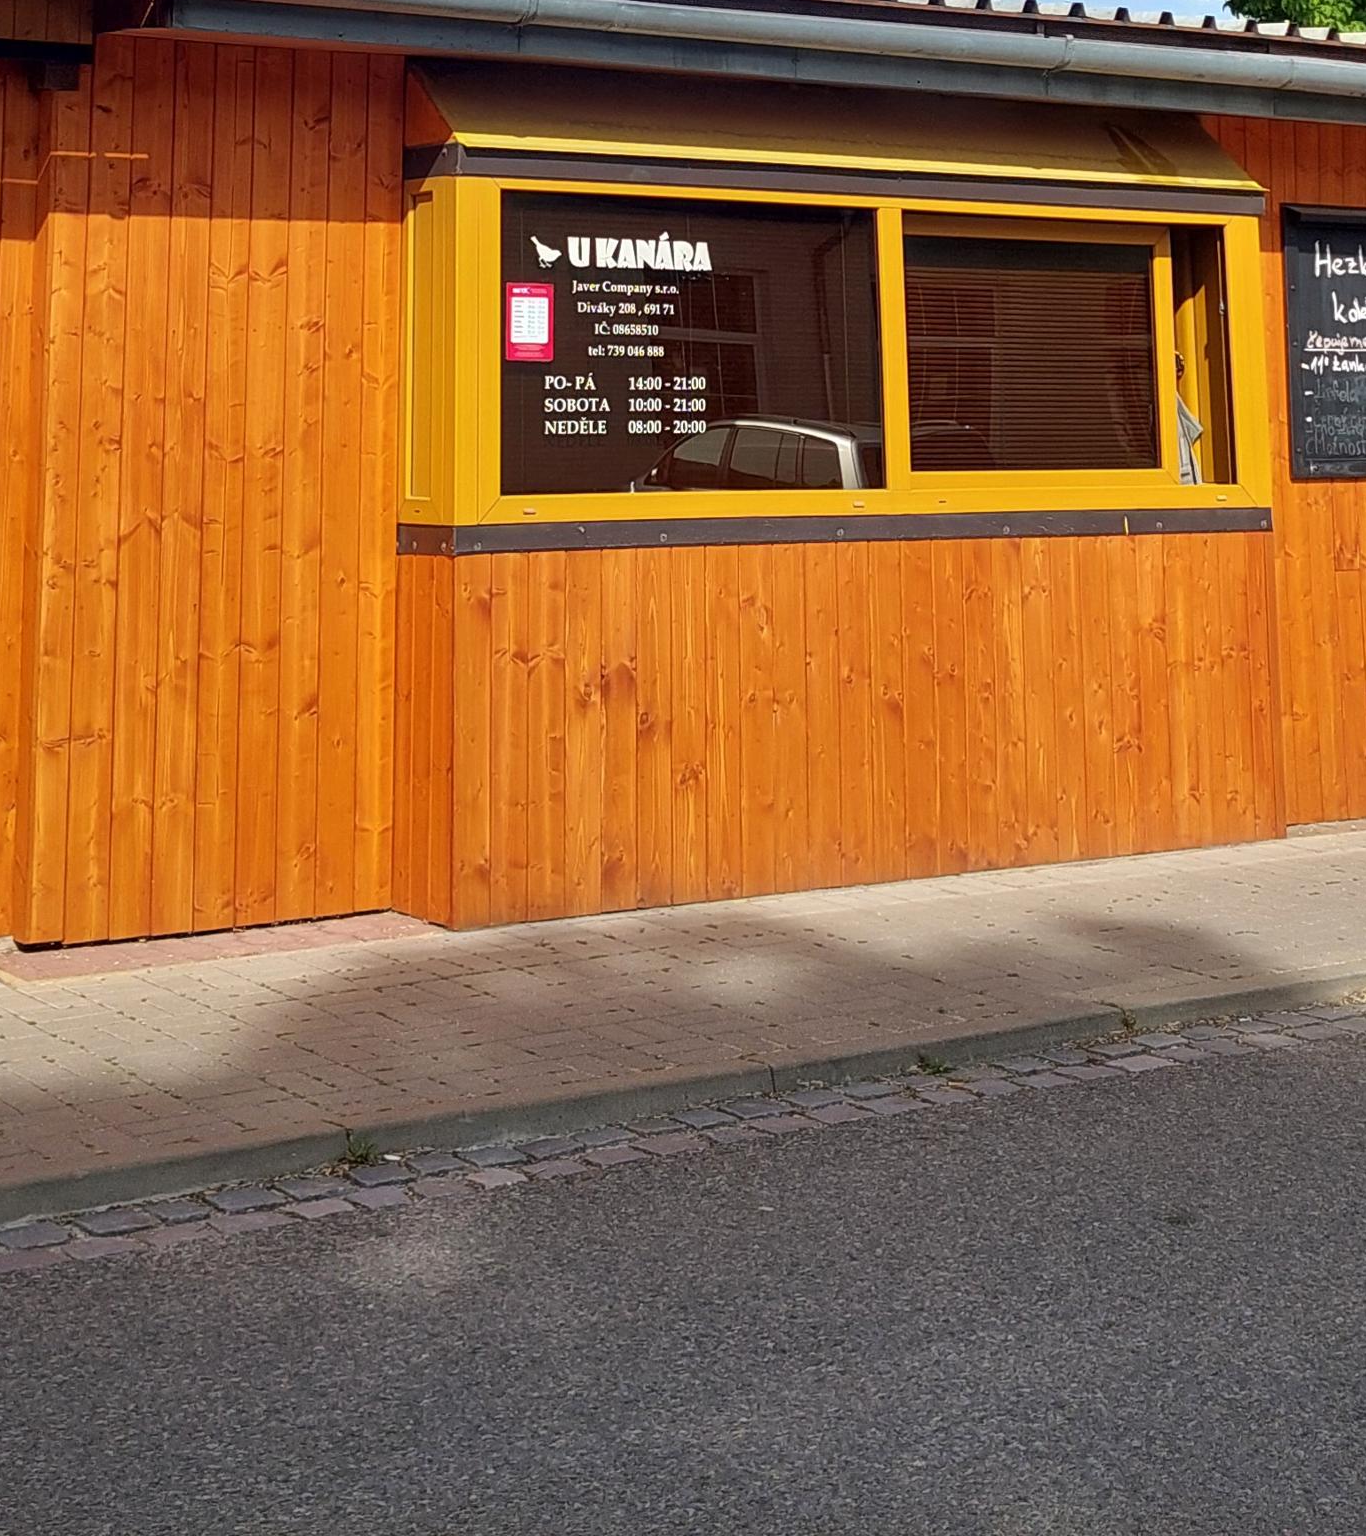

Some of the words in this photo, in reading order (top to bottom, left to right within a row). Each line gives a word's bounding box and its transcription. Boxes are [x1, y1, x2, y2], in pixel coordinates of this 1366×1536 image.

[567, 236, 591, 268] U
[595, 231, 713, 272] KANÁRA
[572, 279, 600, 294] Javer
[602, 281, 653, 297] Company
[655, 285, 680, 295] s.r.o.
[577, 301, 616, 317] Diváky
[618, 303, 636, 314] 208
[644, 304, 660, 315] 691
[663, 304, 675, 316] 71
[612, 324, 659, 336] 08658510
[588, 345, 606, 357] tel:
[607, 345, 625, 357] 739
[627, 346, 645, 357] 046
[647, 346, 665, 358] 888
[575, 372, 597, 390] PÁ
[628, 376, 662, 391] 14:00
[673, 376, 706, 391] 21:00
[544, 397, 611, 413] SOBOTA
[628, 398, 662, 412] 10:00
[673, 398, 706, 412] 21:00
[544, 416, 607, 435] NEDĚLE
[628, 420, 662, 434] 08:00
[673, 419, 707, 434] 20:00
